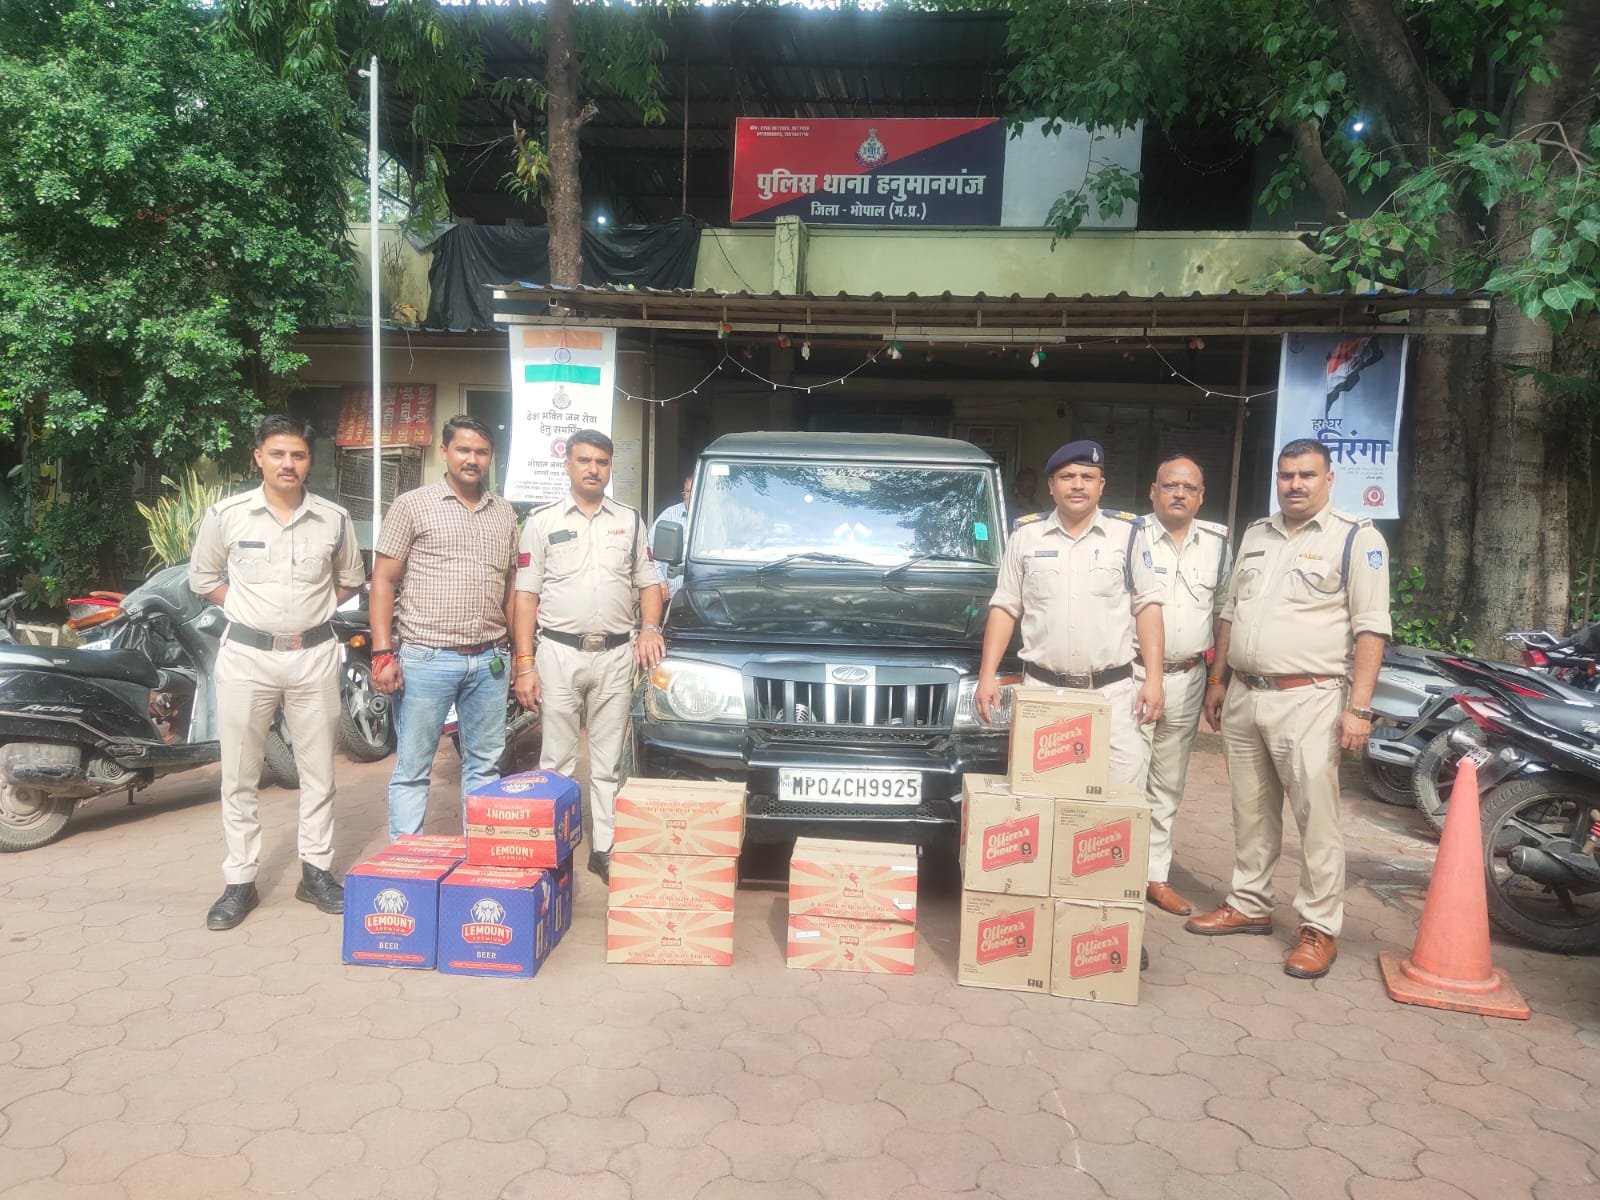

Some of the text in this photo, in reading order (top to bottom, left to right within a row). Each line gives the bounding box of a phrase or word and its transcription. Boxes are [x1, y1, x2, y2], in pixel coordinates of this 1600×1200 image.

[757, 168, 986, 201] पुलिस थाना हनुमानगंज
[811, 202, 839, 217] जिला
[850, 202, 885, 217] भोपाल
[889, 202, 927, 220] (म.प्र.)
[526, 409, 597, 424] देश भक्ति जन सेवा
[1311, 418, 1343, 431] हर घर
[540, 422, 552, 436] हेतु
[1317, 427, 1391, 465] तिरंगा
[18, 704, 84, 714] Activa
[1039, 726, 1082, 748] Officer's
[1037, 743, 1072, 760] Choice
[793, 776, 918, 798] MP04CH9925
[486, 808, 530, 820] LEMOUNT
[988, 826, 1031, 848] Officer's
[1078, 831, 1121, 852] Officer's
[491, 845, 534, 858] LEMOUNT
[986, 843, 1019, 859] Choice
[1076, 848, 1111, 864] Choice
[367, 915, 413, 929] LEMOUNT
[982, 920, 1025, 940] Officer's
[464, 925, 511, 938] LEMOUNT
[379, 942, 399, 950] BEER
[980, 936, 1014, 952] Choice
[1076, 936, 1119, 956] Officer's
[476, 951, 497, 960] BEER
[1074, 951, 1108, 967] Choice
